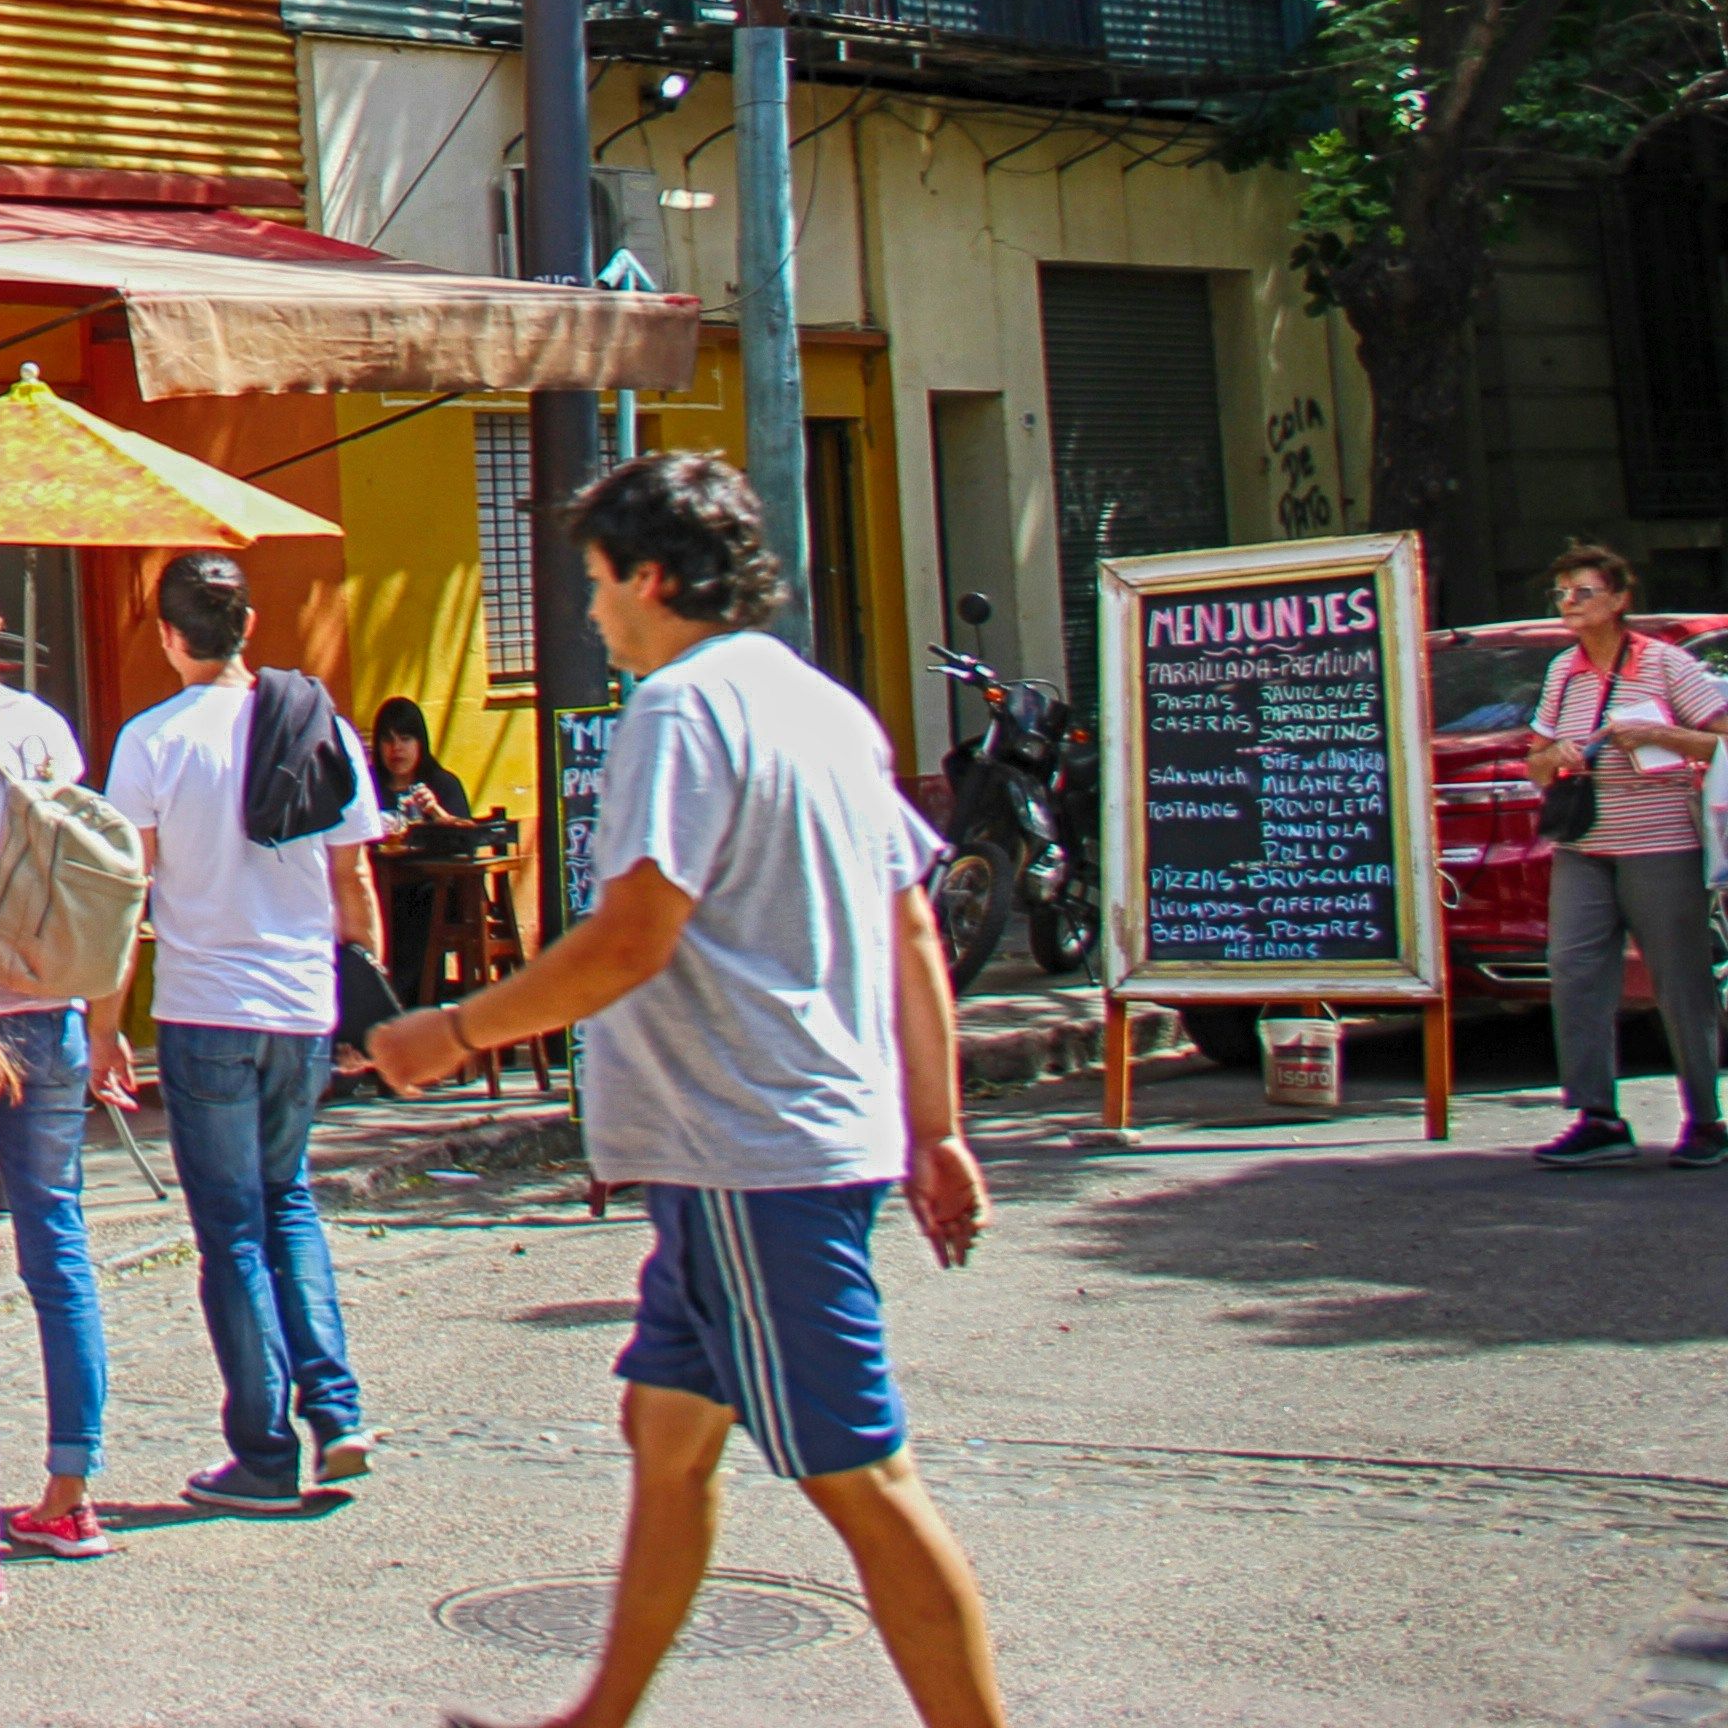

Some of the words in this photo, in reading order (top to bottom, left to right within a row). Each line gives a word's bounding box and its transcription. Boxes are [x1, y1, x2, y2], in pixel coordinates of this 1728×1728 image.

[1148, 588, 1377, 648] MENJUNJES
[1151, 693, 1236, 711] PASTAS
[1150, 714, 1253, 734] CASERAS
[1260, 840, 1347, 861] POLLO
